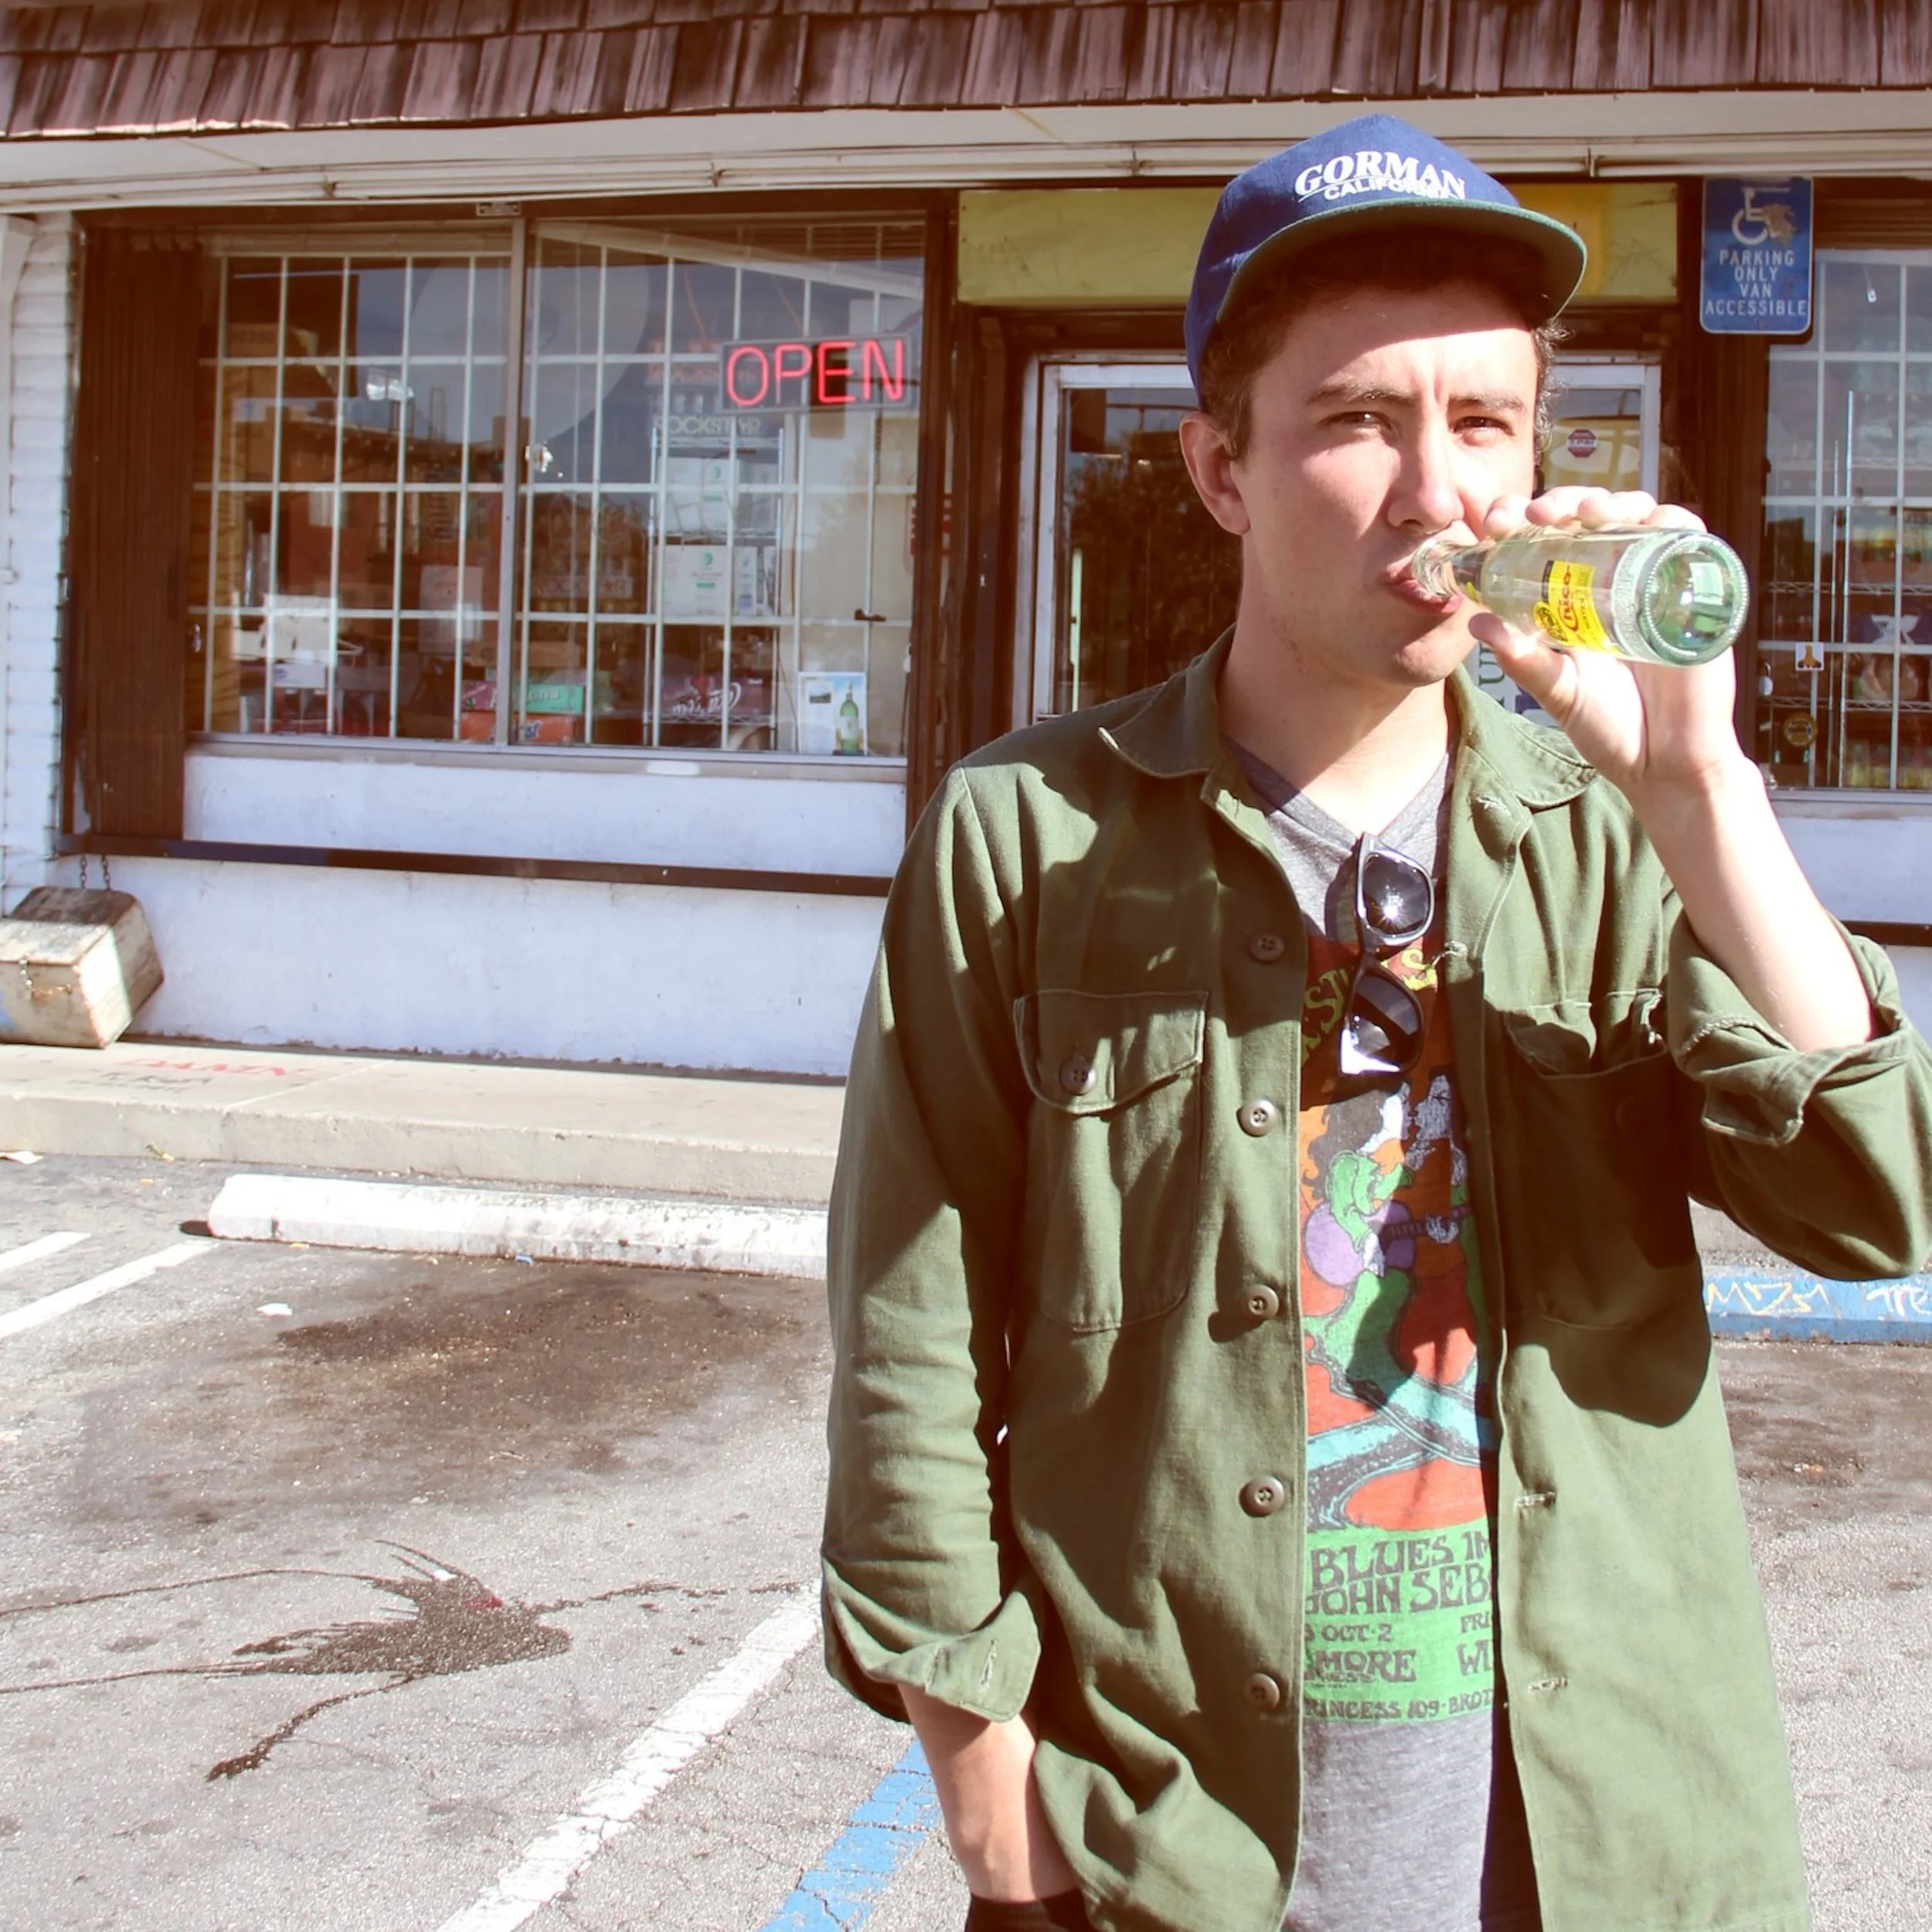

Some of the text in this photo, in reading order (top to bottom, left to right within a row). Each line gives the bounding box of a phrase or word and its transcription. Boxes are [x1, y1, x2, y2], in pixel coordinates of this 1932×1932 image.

[1294, 151, 1465, 200] GORMAN
[1719, 249, 1795, 267] PARKING
[1734, 267, 1778, 282] ONLY
[1739, 283, 1772, 298] VAN
[1705, 300, 1808, 317] ACCESSIBLE
[726, 338, 905, 407] OPEN
[1310, 1534, 1454, 1591] BLUES
[1304, 1563, 1492, 1615] JOHN SEB
